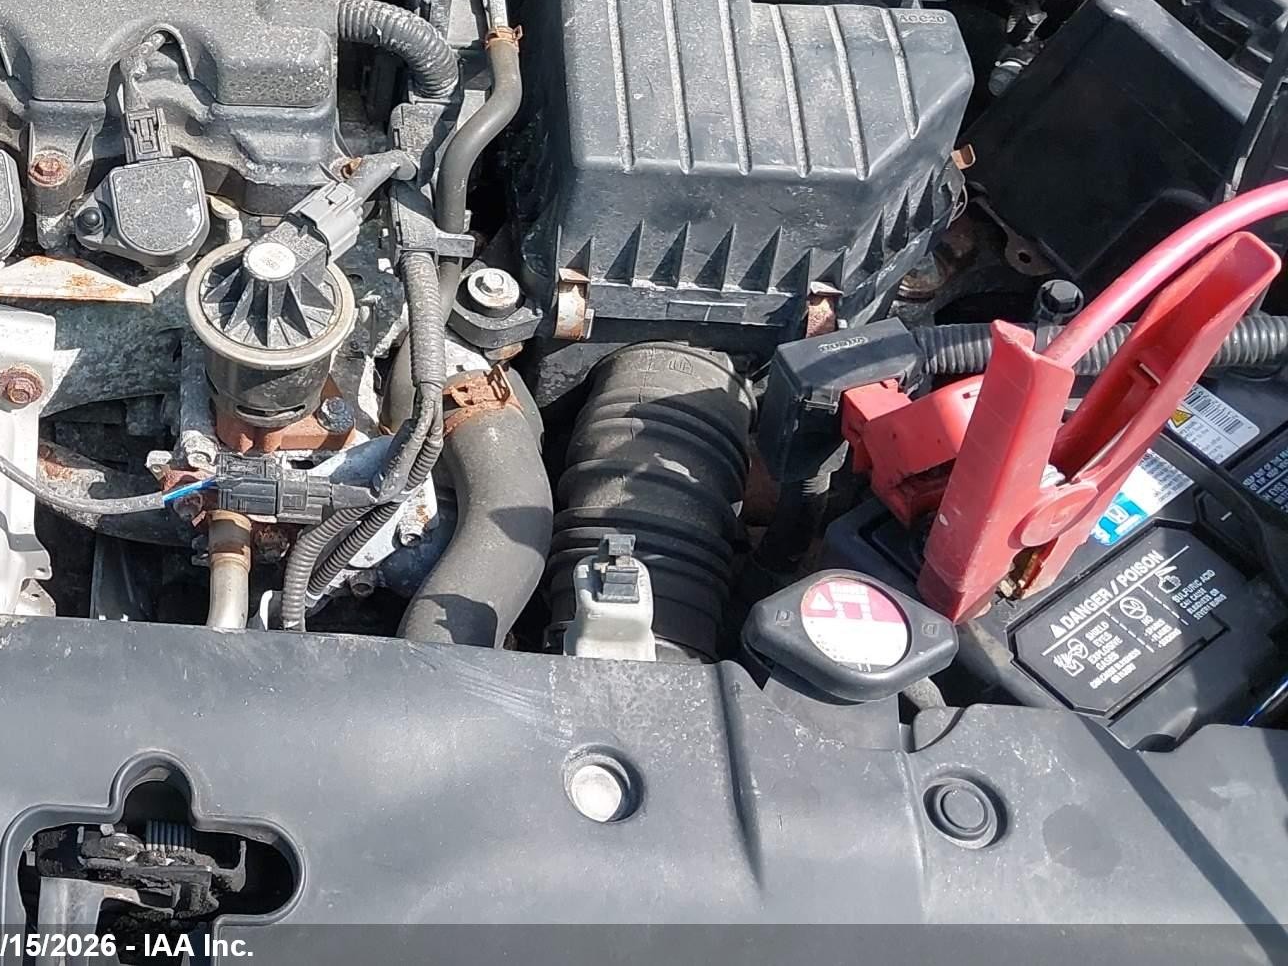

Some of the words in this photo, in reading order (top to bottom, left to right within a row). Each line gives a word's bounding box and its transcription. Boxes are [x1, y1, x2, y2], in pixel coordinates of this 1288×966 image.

[1059, 586, 1113, 629] DANGER
[1117, 549, 1164, 587] POISON
[1172, 578, 1202, 603] SULFURIC
[1199, 568, 1215, 582] ACID
[1087, 635, 1123, 664] EXPLOSIVE
